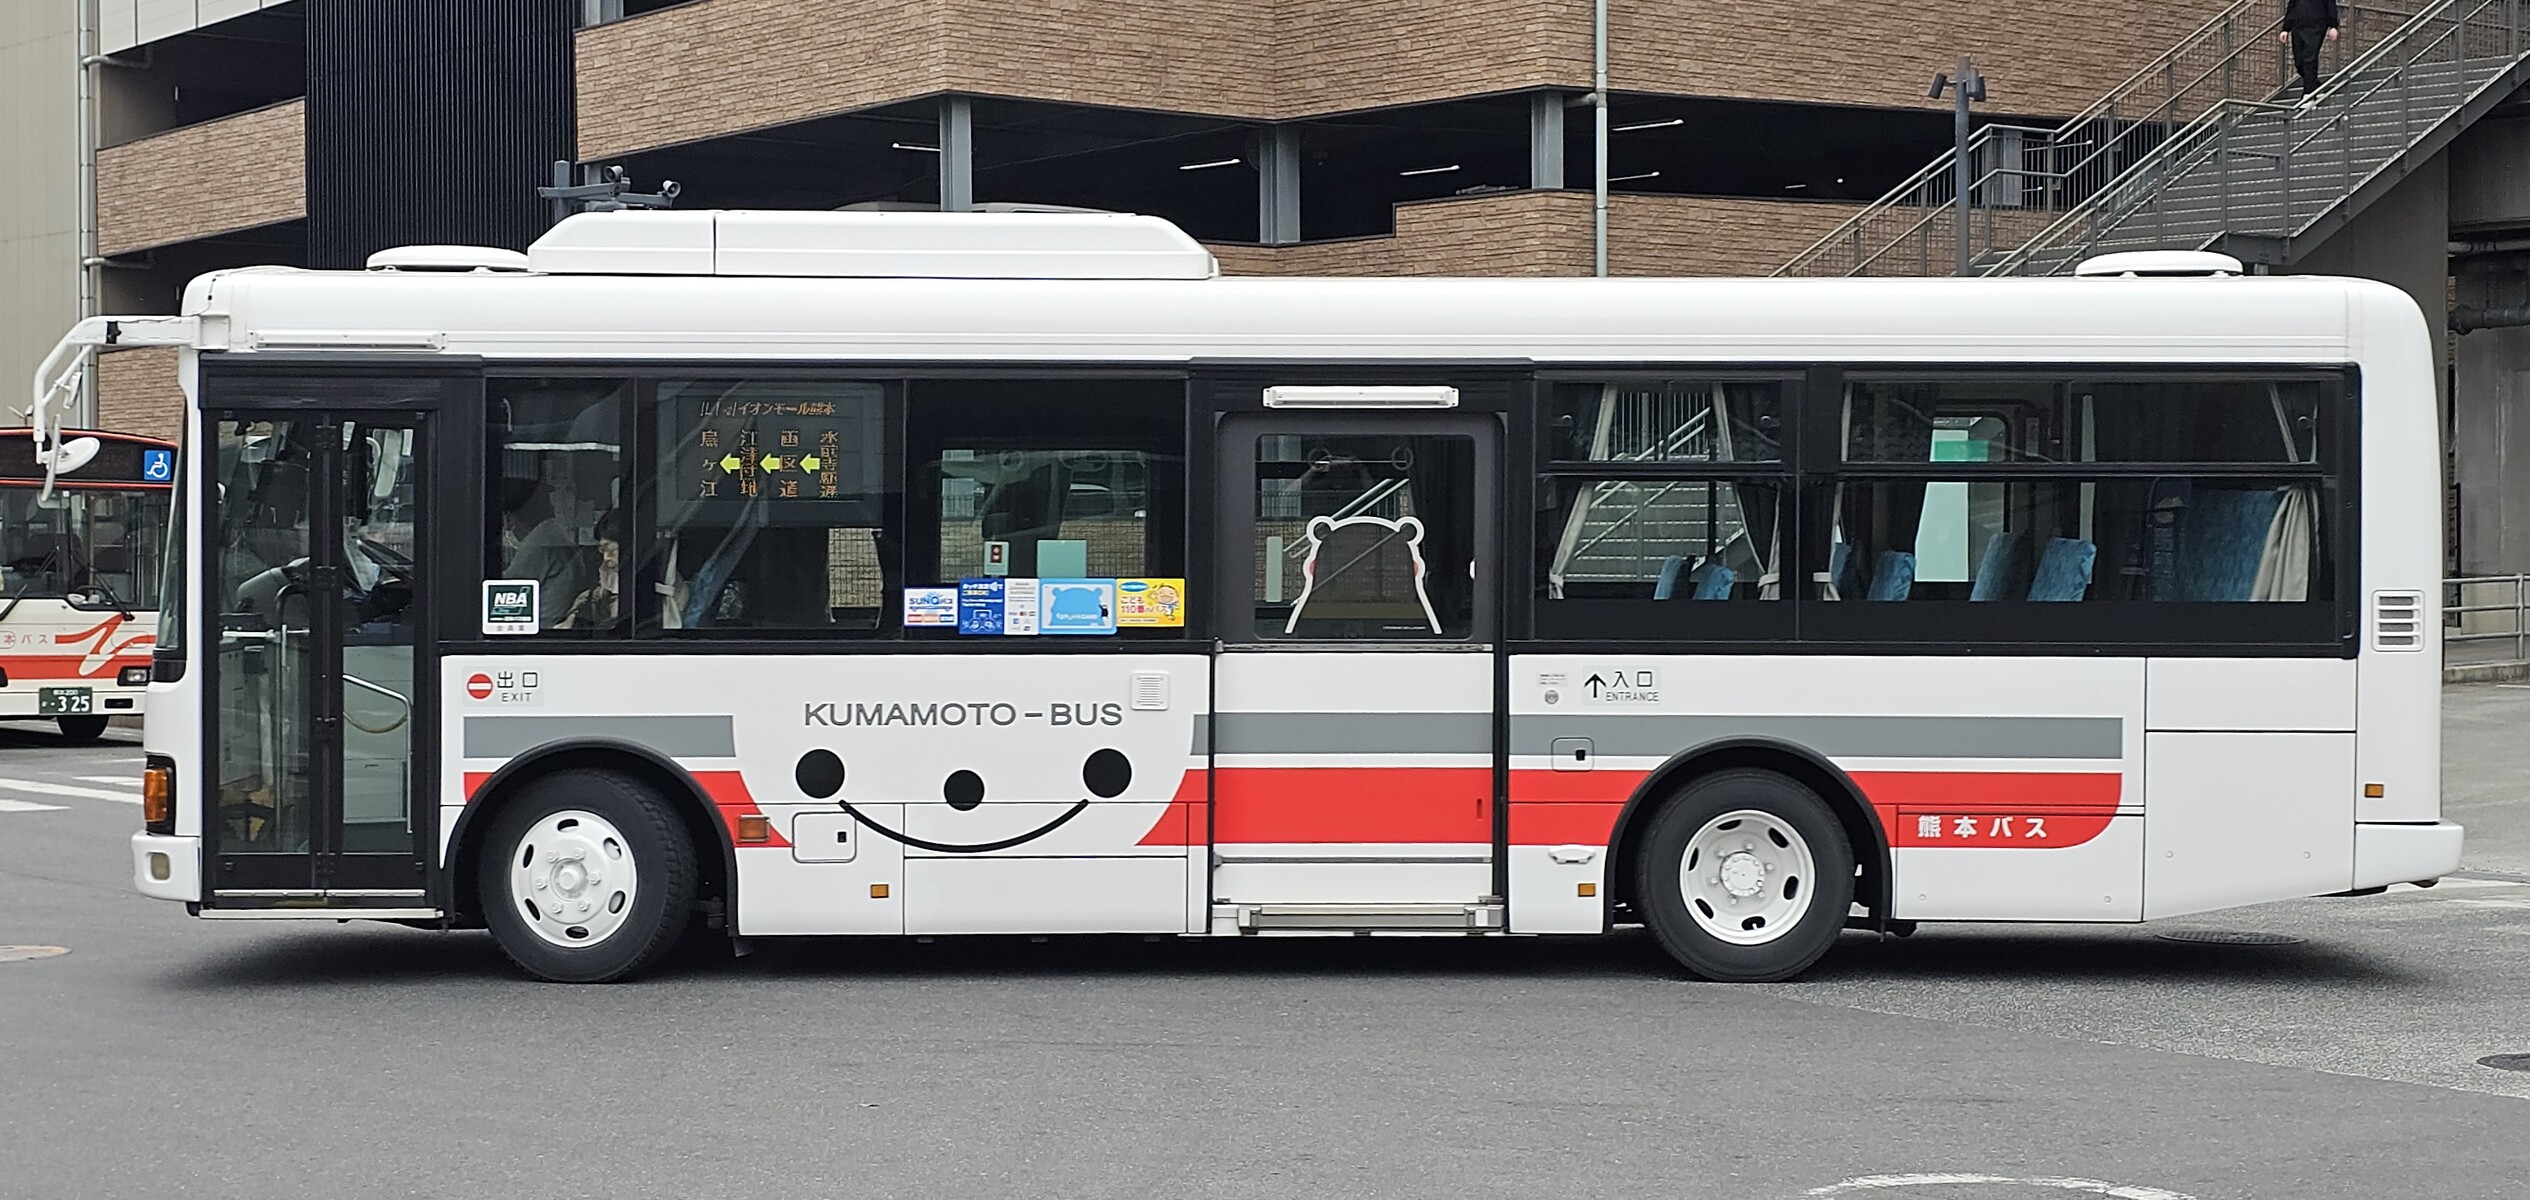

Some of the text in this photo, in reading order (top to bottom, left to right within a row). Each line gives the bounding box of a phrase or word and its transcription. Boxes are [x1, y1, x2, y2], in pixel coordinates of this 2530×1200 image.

[494, 591, 527, 604] NBA
[497, 671, 538, 688] 出口
[1612, 671, 1653, 688] 入口
[502, 692, 532, 702] EXIT
[1606, 692, 1660, 703] ENTRANCE
[1917, 814, 2048, 838] 熊本バス
